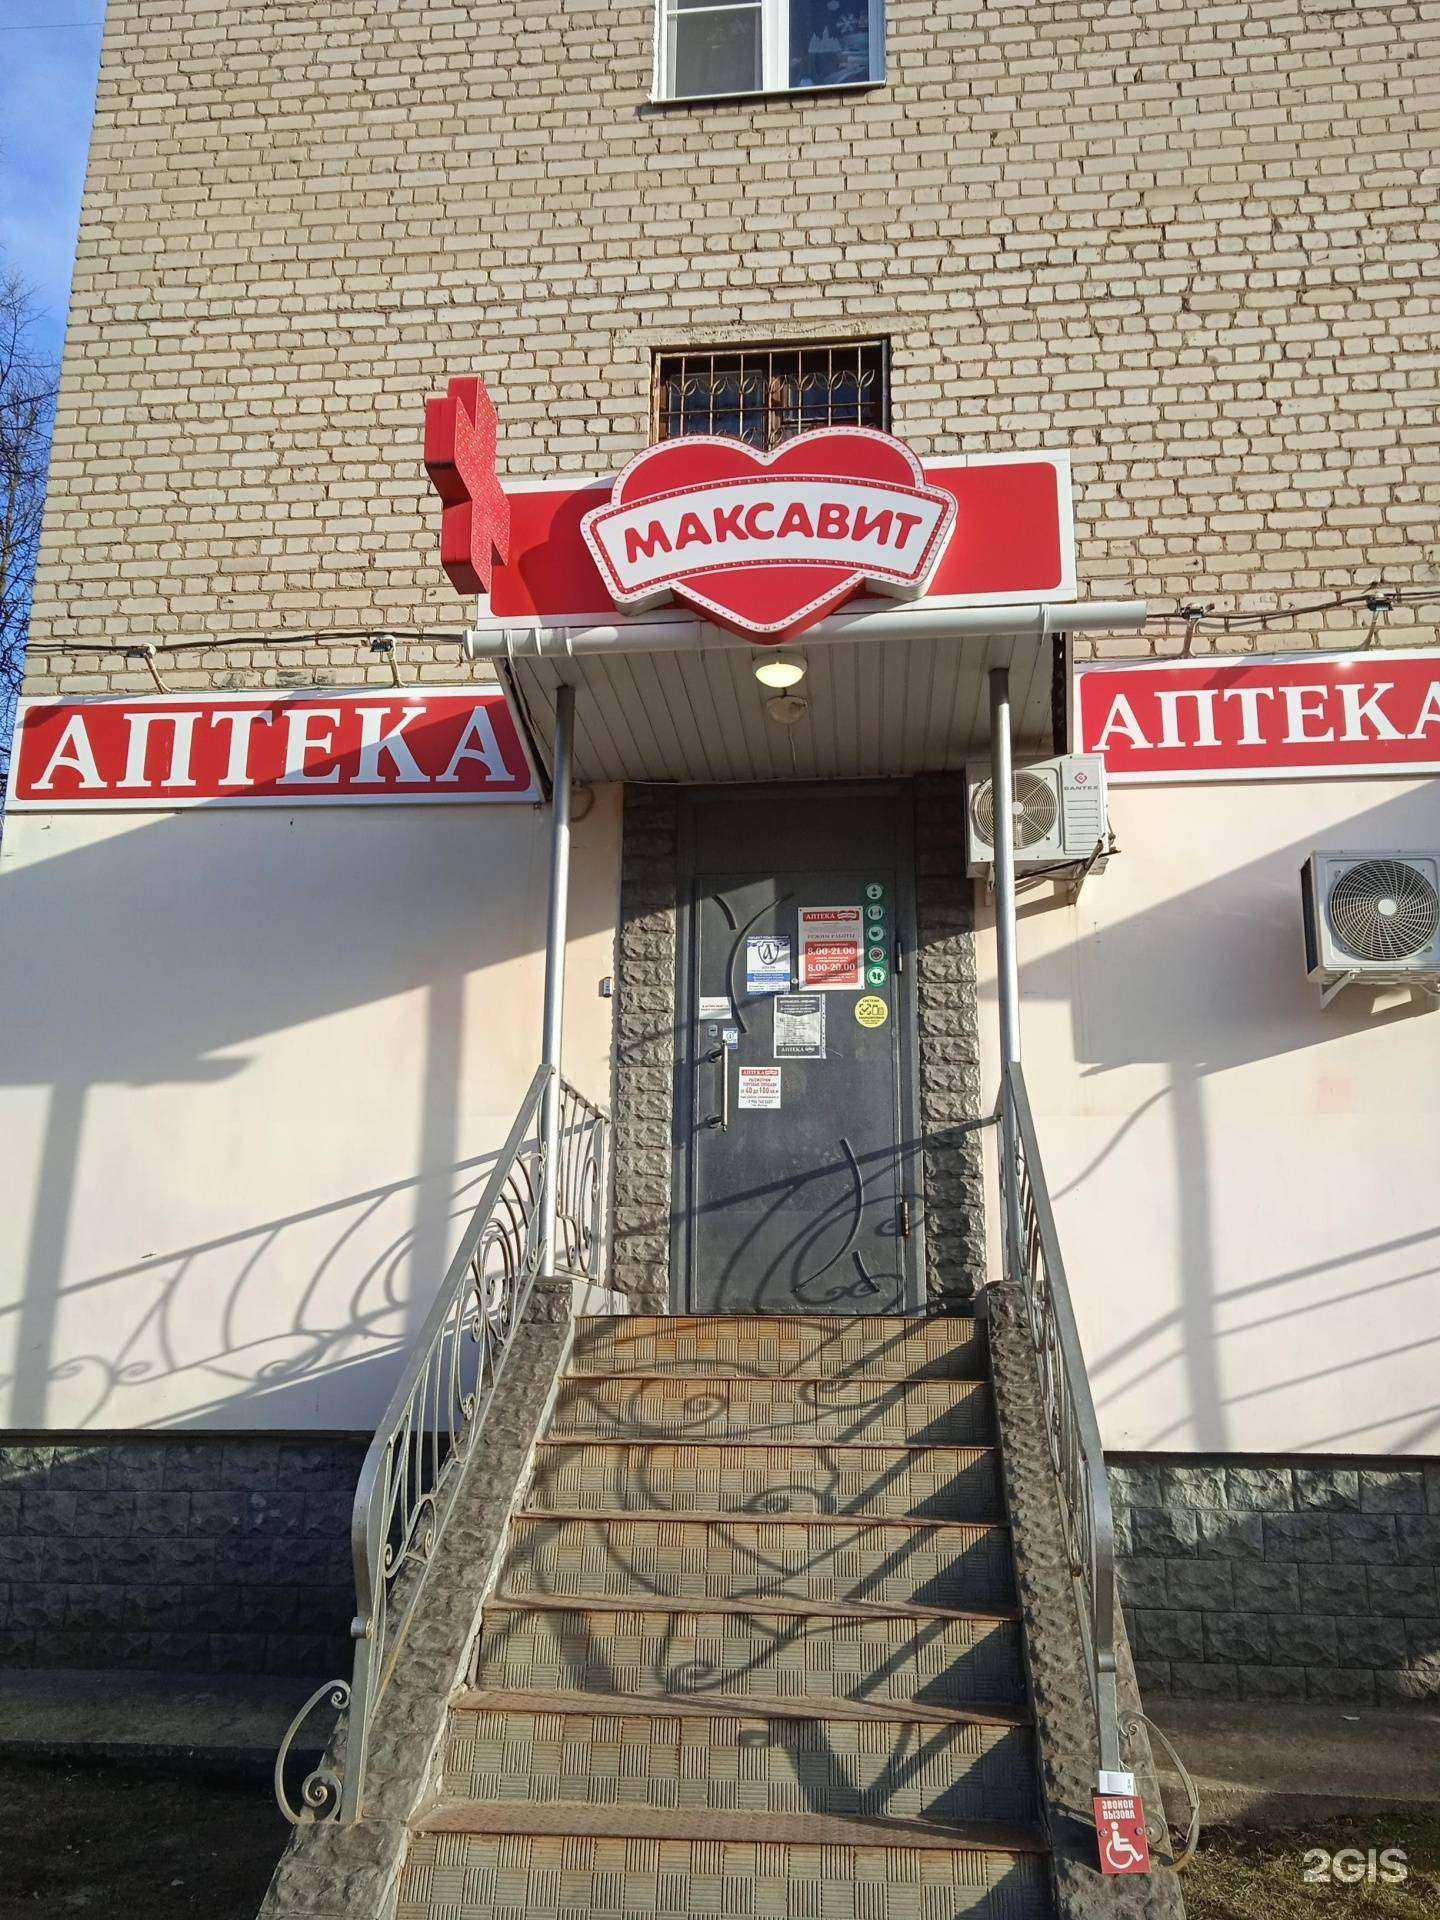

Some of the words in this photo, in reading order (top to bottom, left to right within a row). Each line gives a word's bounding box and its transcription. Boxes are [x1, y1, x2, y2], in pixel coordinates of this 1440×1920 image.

[624, 502, 922, 563] МАКСАВИТ
[31, 705, 516, 789] АПТЕКА
[1101, 1799, 1135, 1810] ЗВОНОК
[1102, 1809, 1136, 1820] ВЫЗОВА
